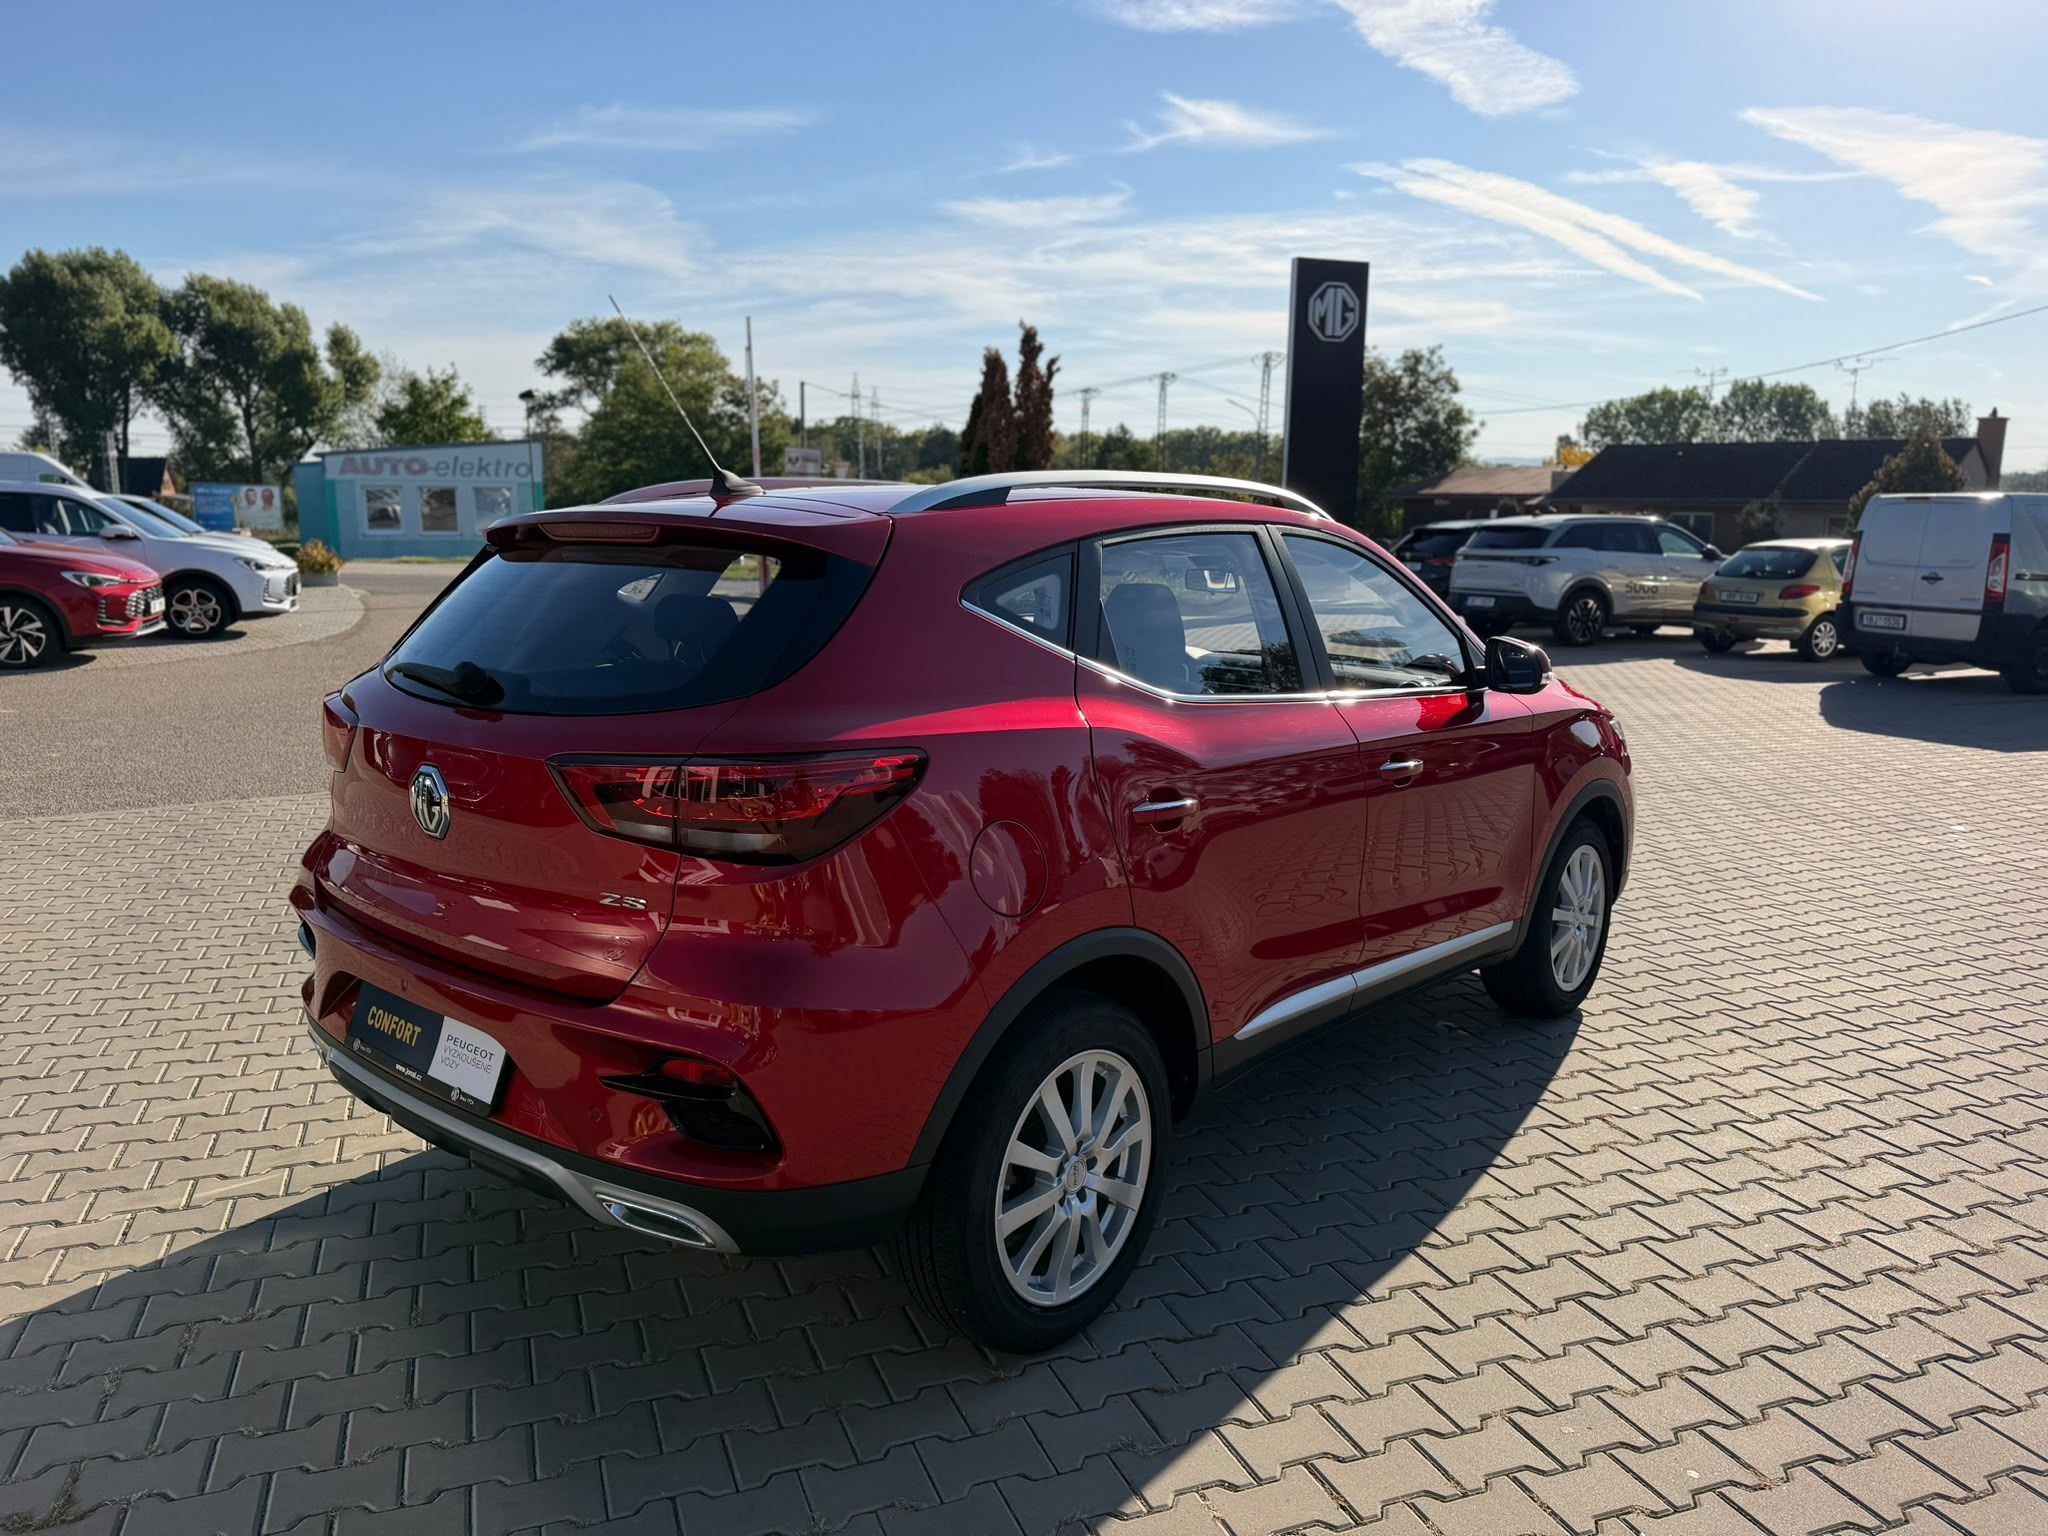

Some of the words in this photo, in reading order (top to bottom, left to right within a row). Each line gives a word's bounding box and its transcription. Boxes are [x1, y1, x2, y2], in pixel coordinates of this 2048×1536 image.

[1312, 286, 1356, 337] MG
[339, 456, 531, 478] AUTO-elektro
[409, 769, 444, 834] MG
[599, 892, 648, 910] ZS
[367, 1005, 422, 1047] CONFORT
[446, 1033, 495, 1062] PEUGEOT
[441, 1055, 460, 1070] VOZY
